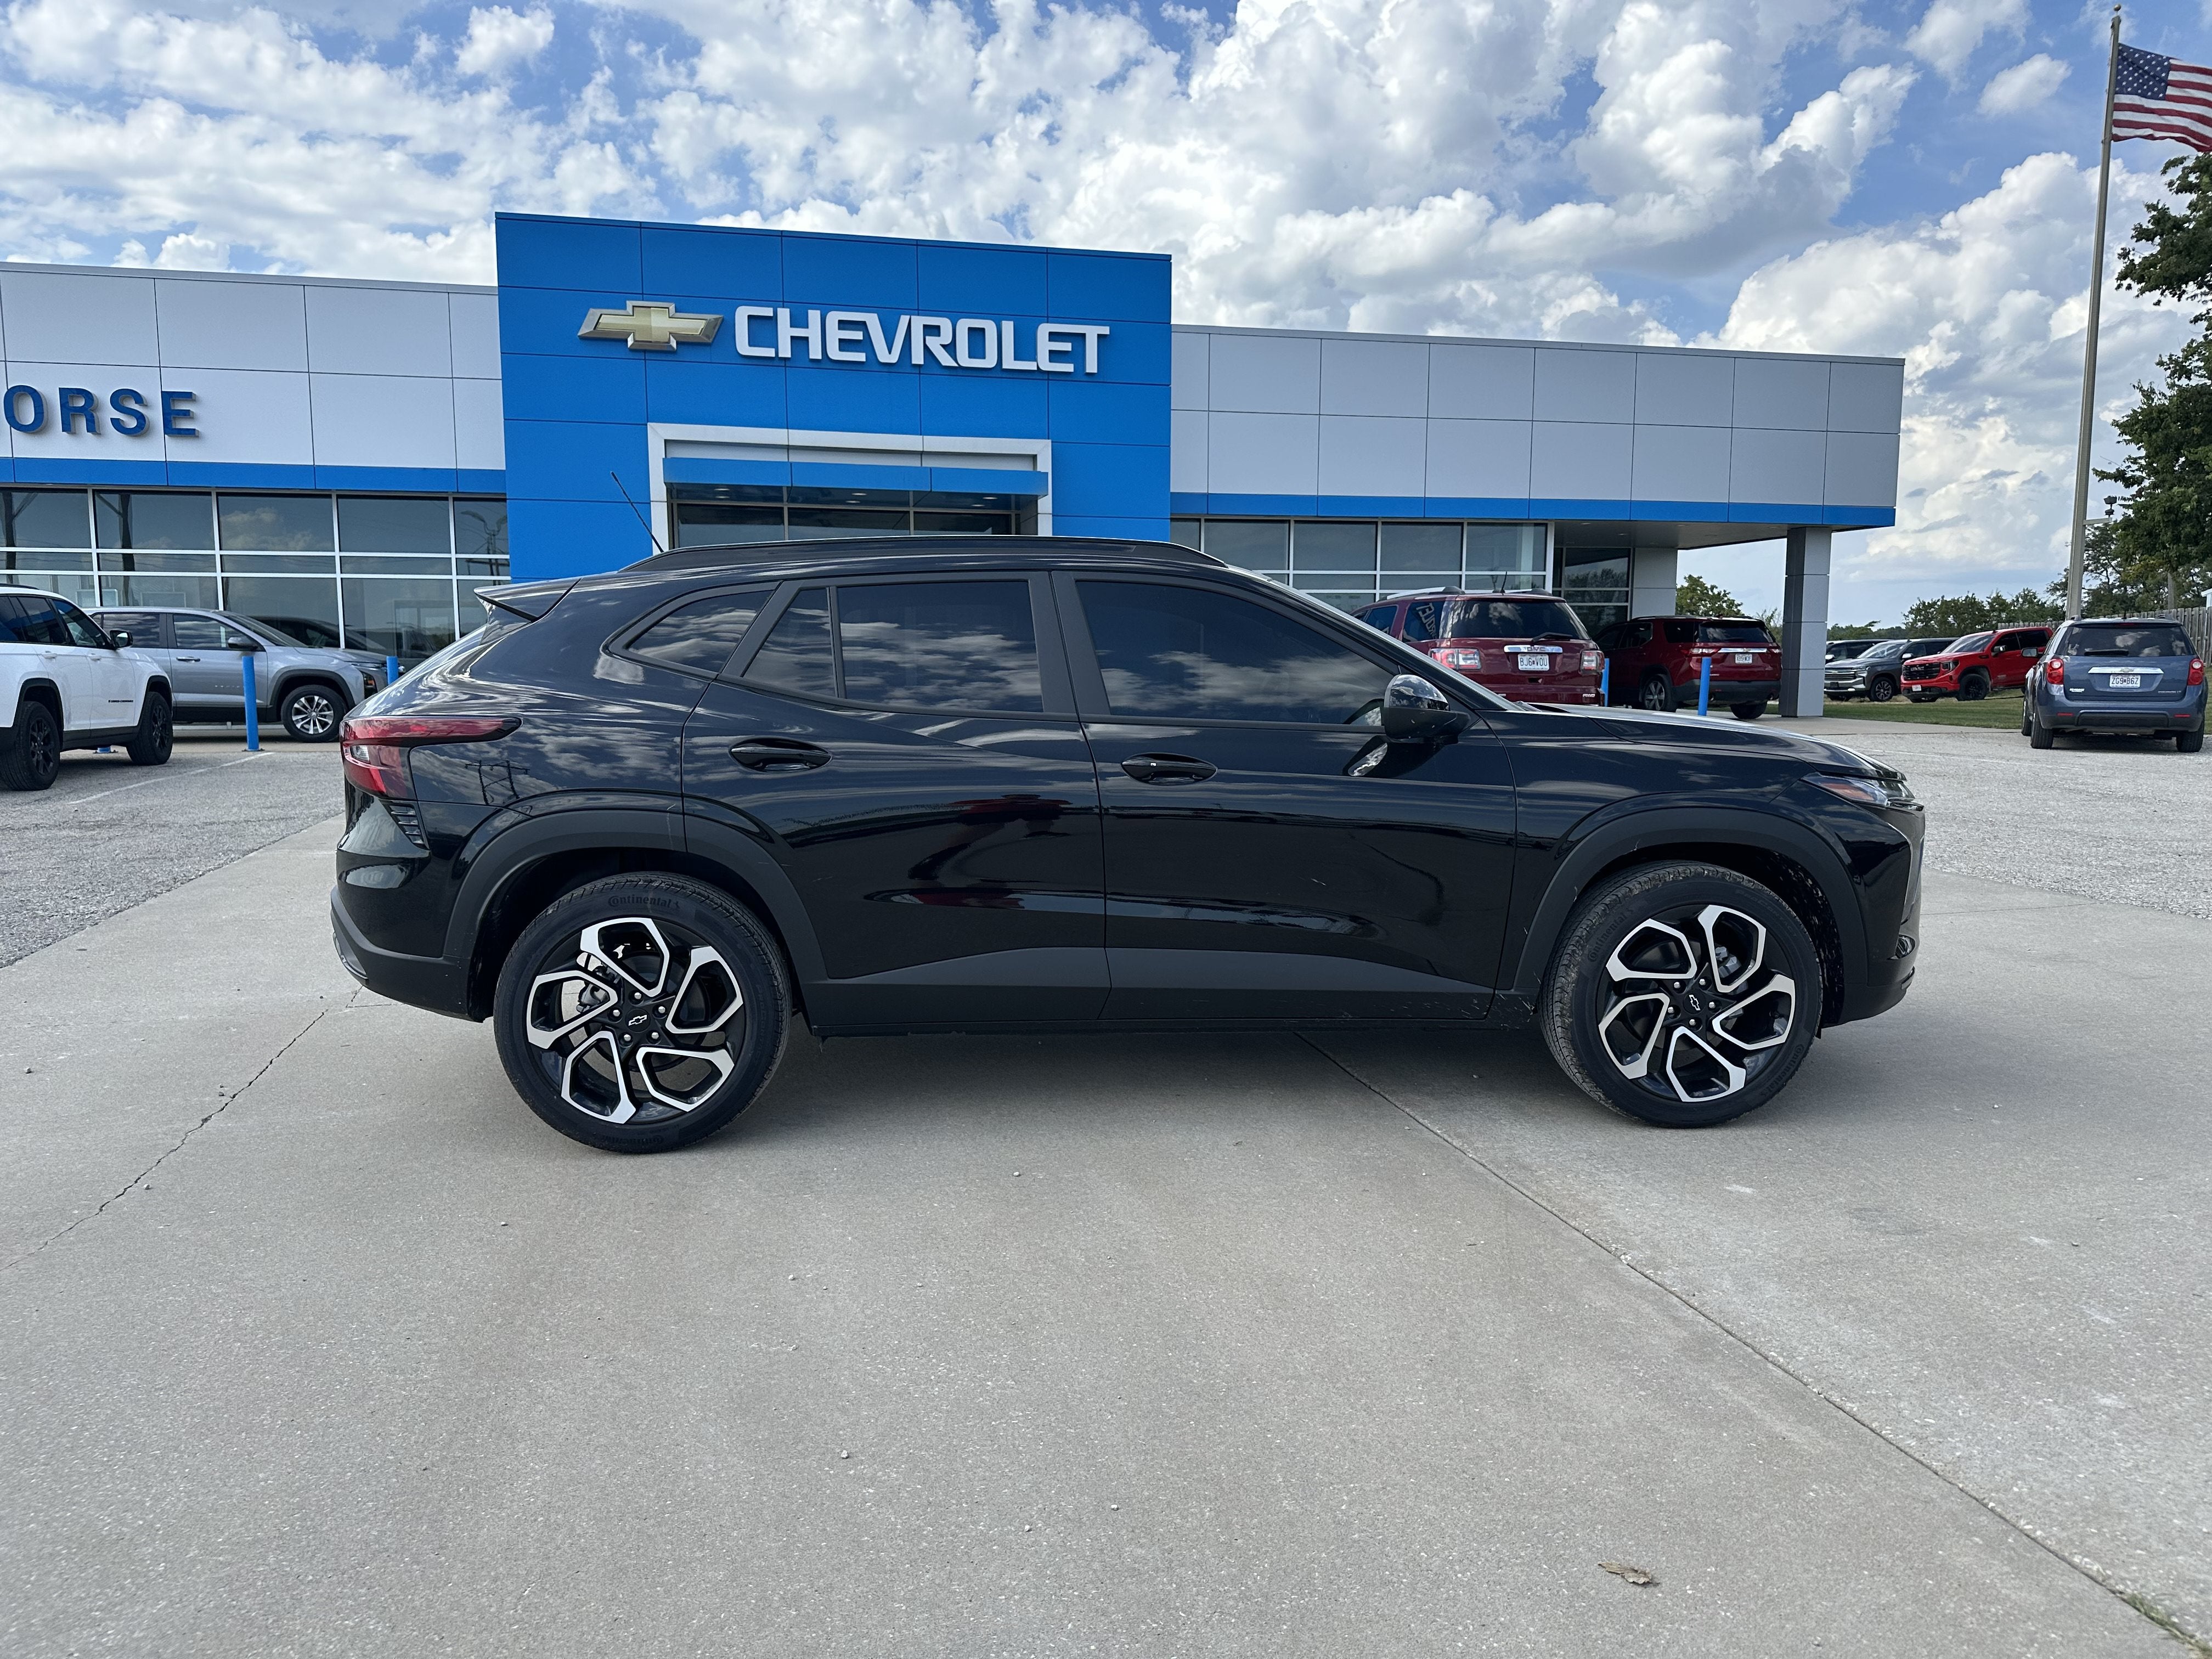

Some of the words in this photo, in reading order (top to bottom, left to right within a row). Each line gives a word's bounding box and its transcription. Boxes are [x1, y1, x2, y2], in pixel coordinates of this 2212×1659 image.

[735, 305, 1110, 373] CHEVROLET
[607, 894, 672, 909] Continental
[1587, 912, 1628, 962] Continental
[1766, 1044, 1804, 1092] Continental
